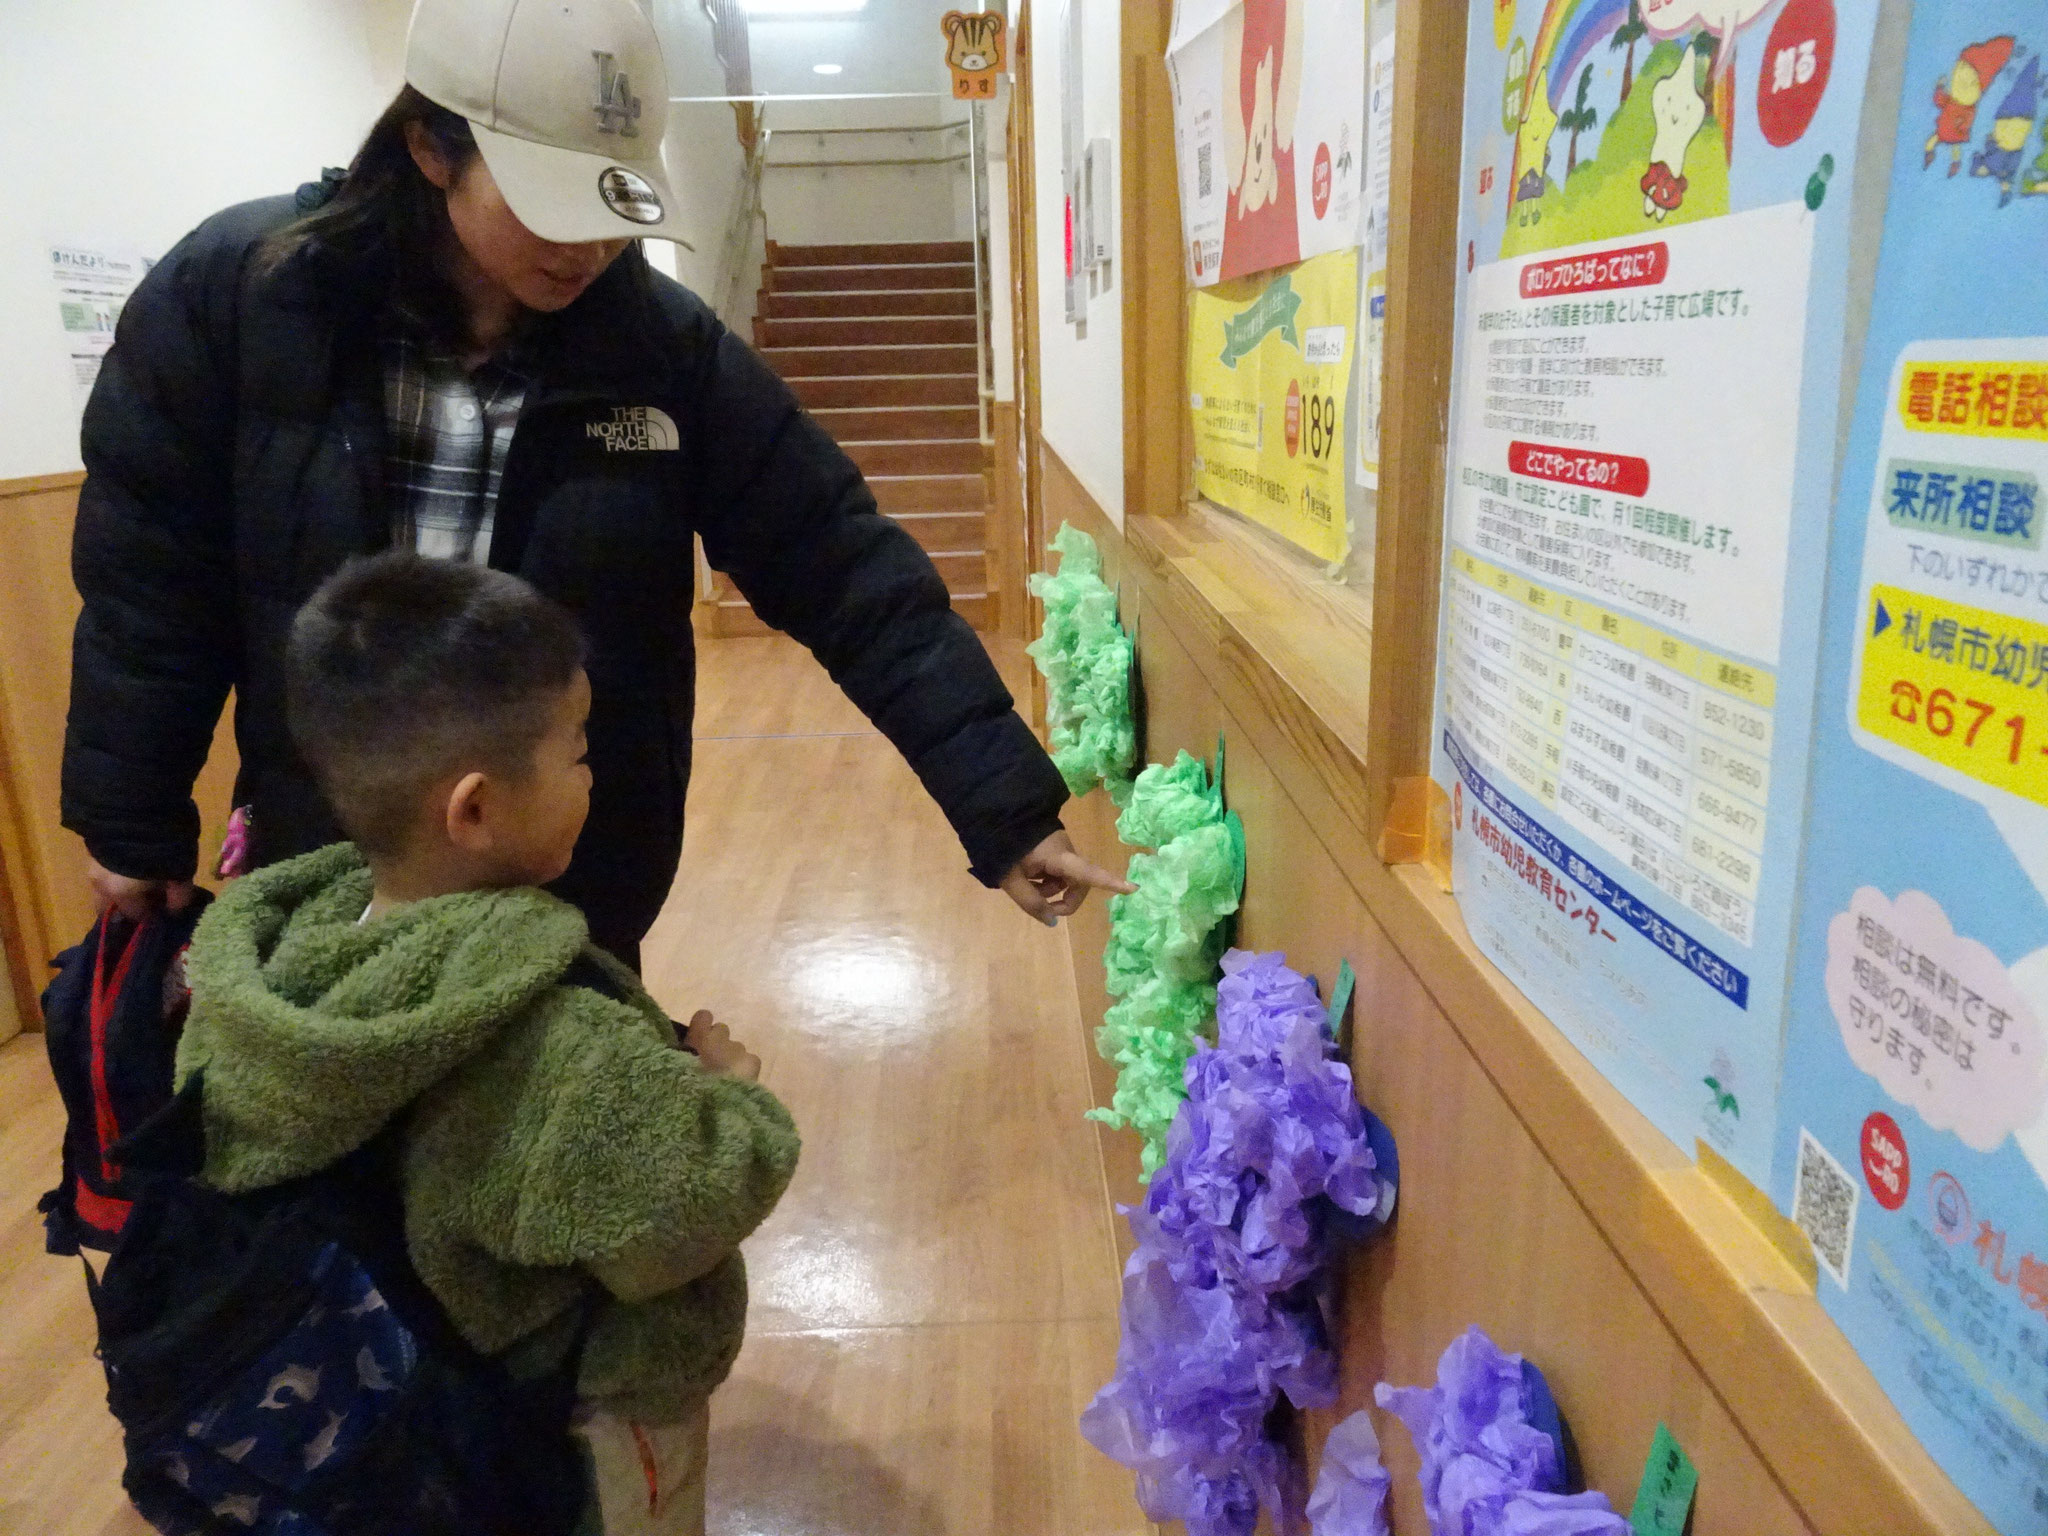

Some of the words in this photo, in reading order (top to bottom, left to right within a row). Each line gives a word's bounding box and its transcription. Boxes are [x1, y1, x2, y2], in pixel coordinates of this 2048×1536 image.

[958, 77, 989, 95] りす
[1771, 39, 1816, 95] 知る
[585, 421, 647, 438] NORTH
[610, 406, 647, 422] THE
[1301, 393, 1335, 460] 189
[1907, 370, 2048, 430] 電話相談
[605, 435, 649, 452] FACE
[1889, 468, 2038, 541] 来所相談
[1471, 804, 1617, 943] 札幌市幼児教育センター
[1852, 955, 1975, 1072] 相談の秘密は
[1857, 913, 2021, 1056] 相談は無料です。
[1849, 994, 1934, 1090] 守ります。
